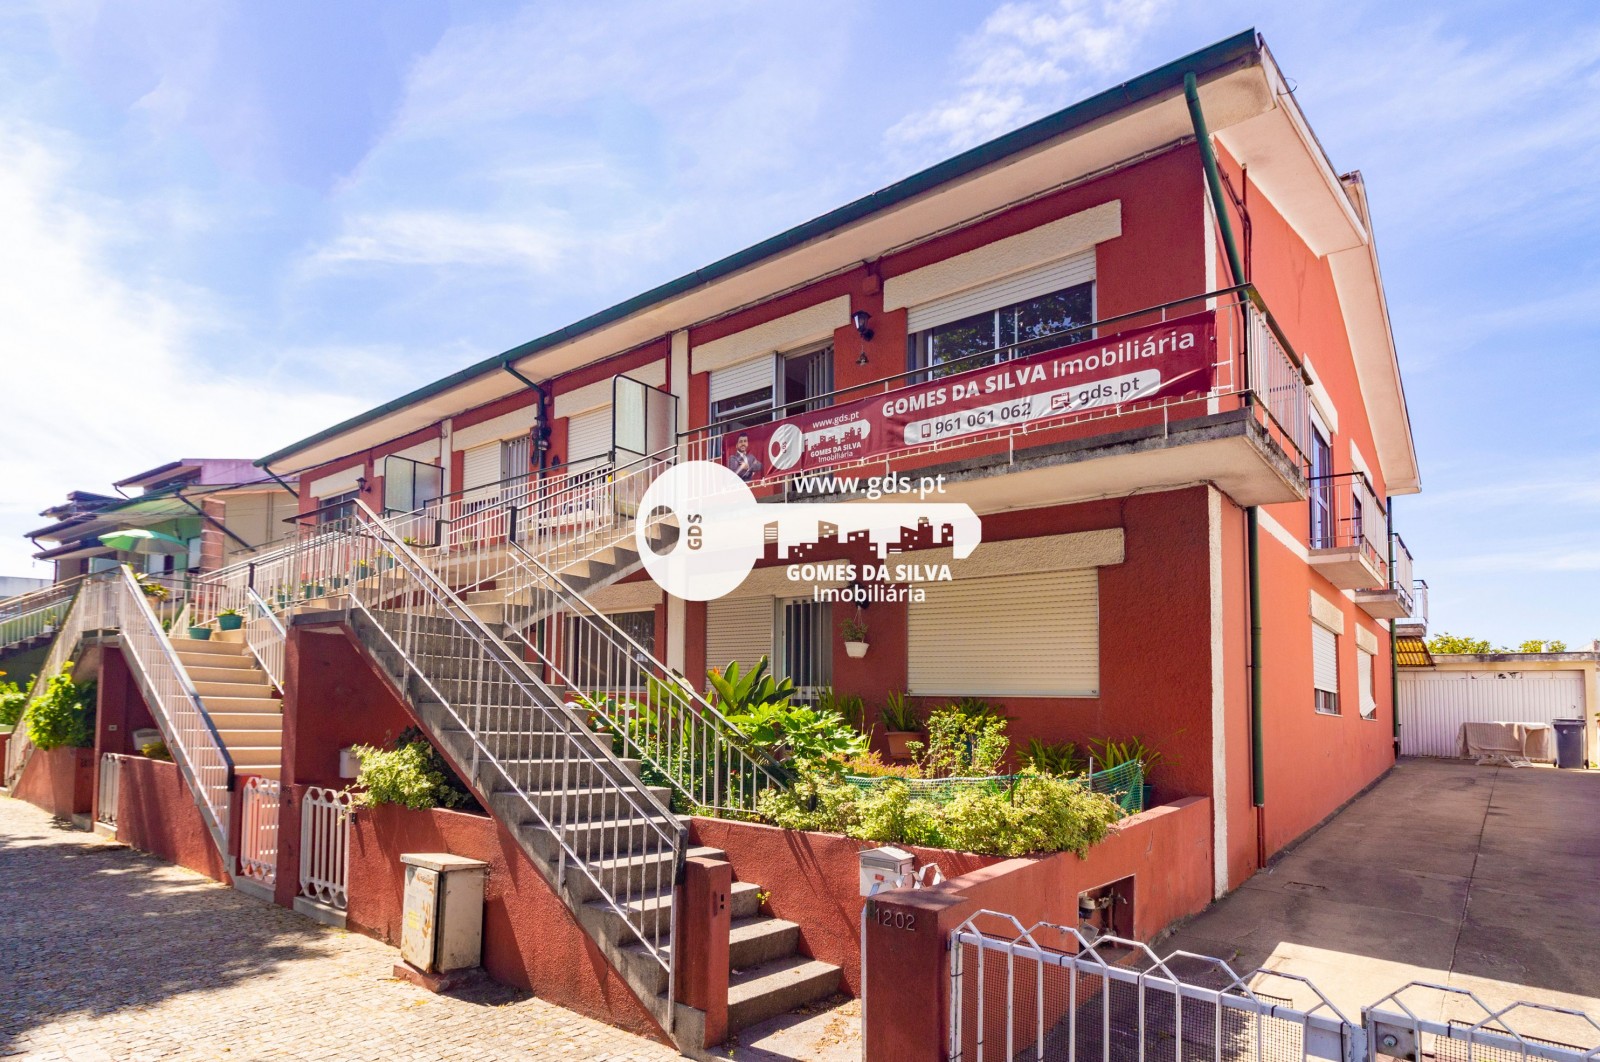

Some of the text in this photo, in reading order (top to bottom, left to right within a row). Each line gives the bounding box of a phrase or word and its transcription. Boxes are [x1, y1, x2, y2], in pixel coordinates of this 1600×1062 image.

[882, 331, 1196, 417] GOMES DA SILVA Imobiliária
[1078, 376, 1141, 405] gds.pt
[812, 411, 860, 428] www.gds.pt
[935, 402, 1032, 435] 961 061 062
[810, 448, 832, 458] GOMES
[843, 441, 862, 450] SILVA
[818, 451, 854, 463] Imobiliária
[876, 908, 916, 931] 1202
